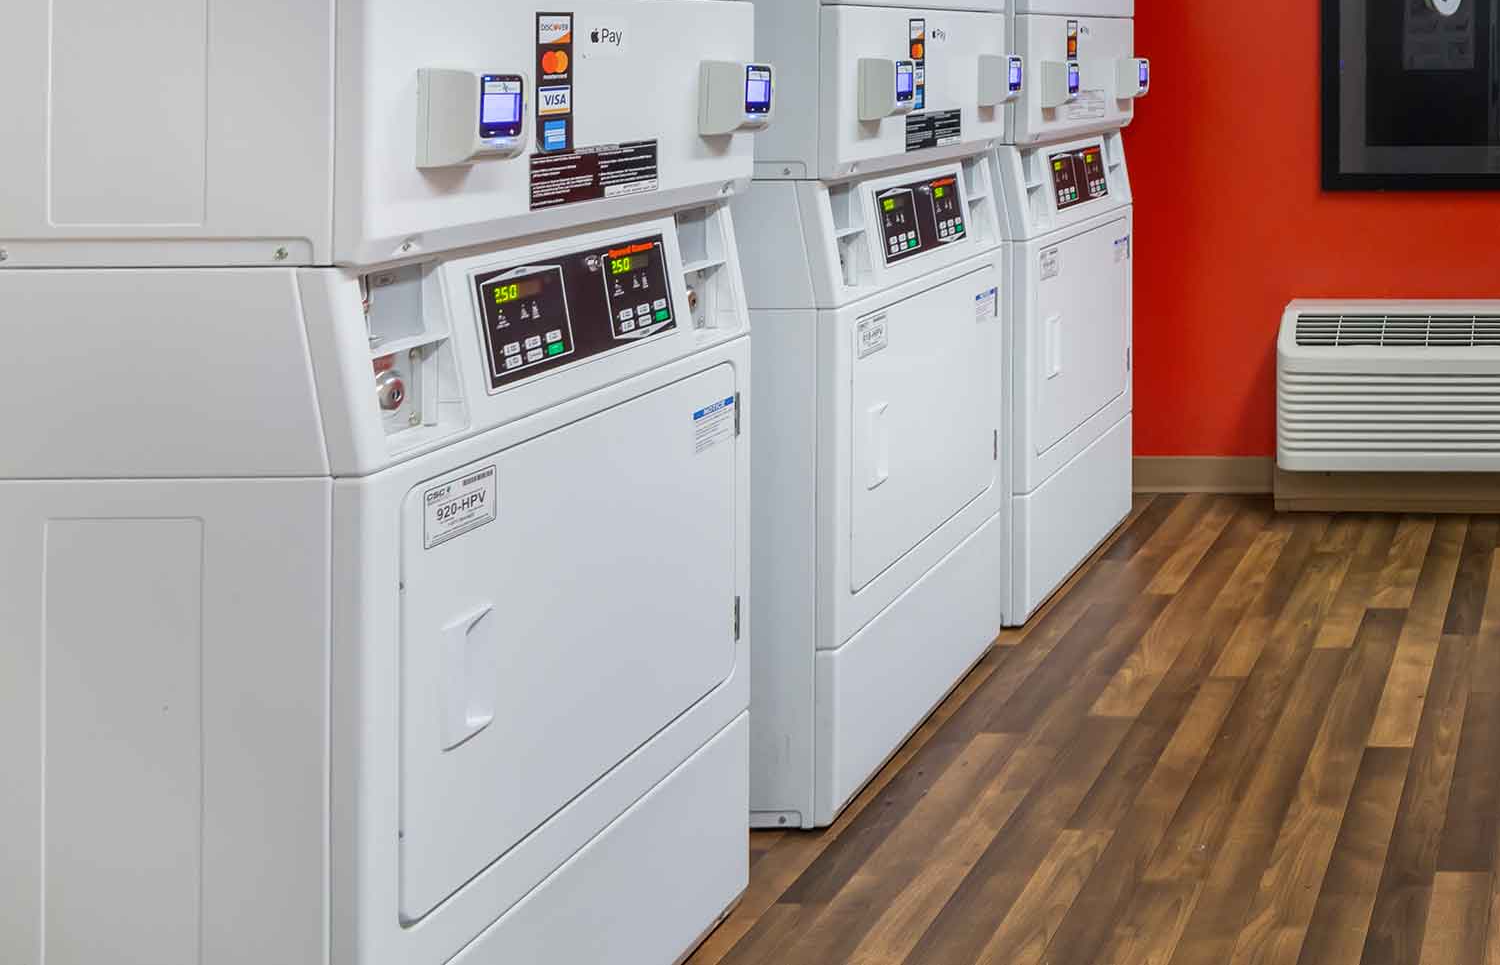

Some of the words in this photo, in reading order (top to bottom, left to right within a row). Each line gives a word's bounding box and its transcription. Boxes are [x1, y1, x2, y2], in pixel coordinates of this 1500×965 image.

[601, 27, 623, 46] Pay
[543, 93, 567, 106] VISA
[436, 489, 487, 520] 920-HPV
